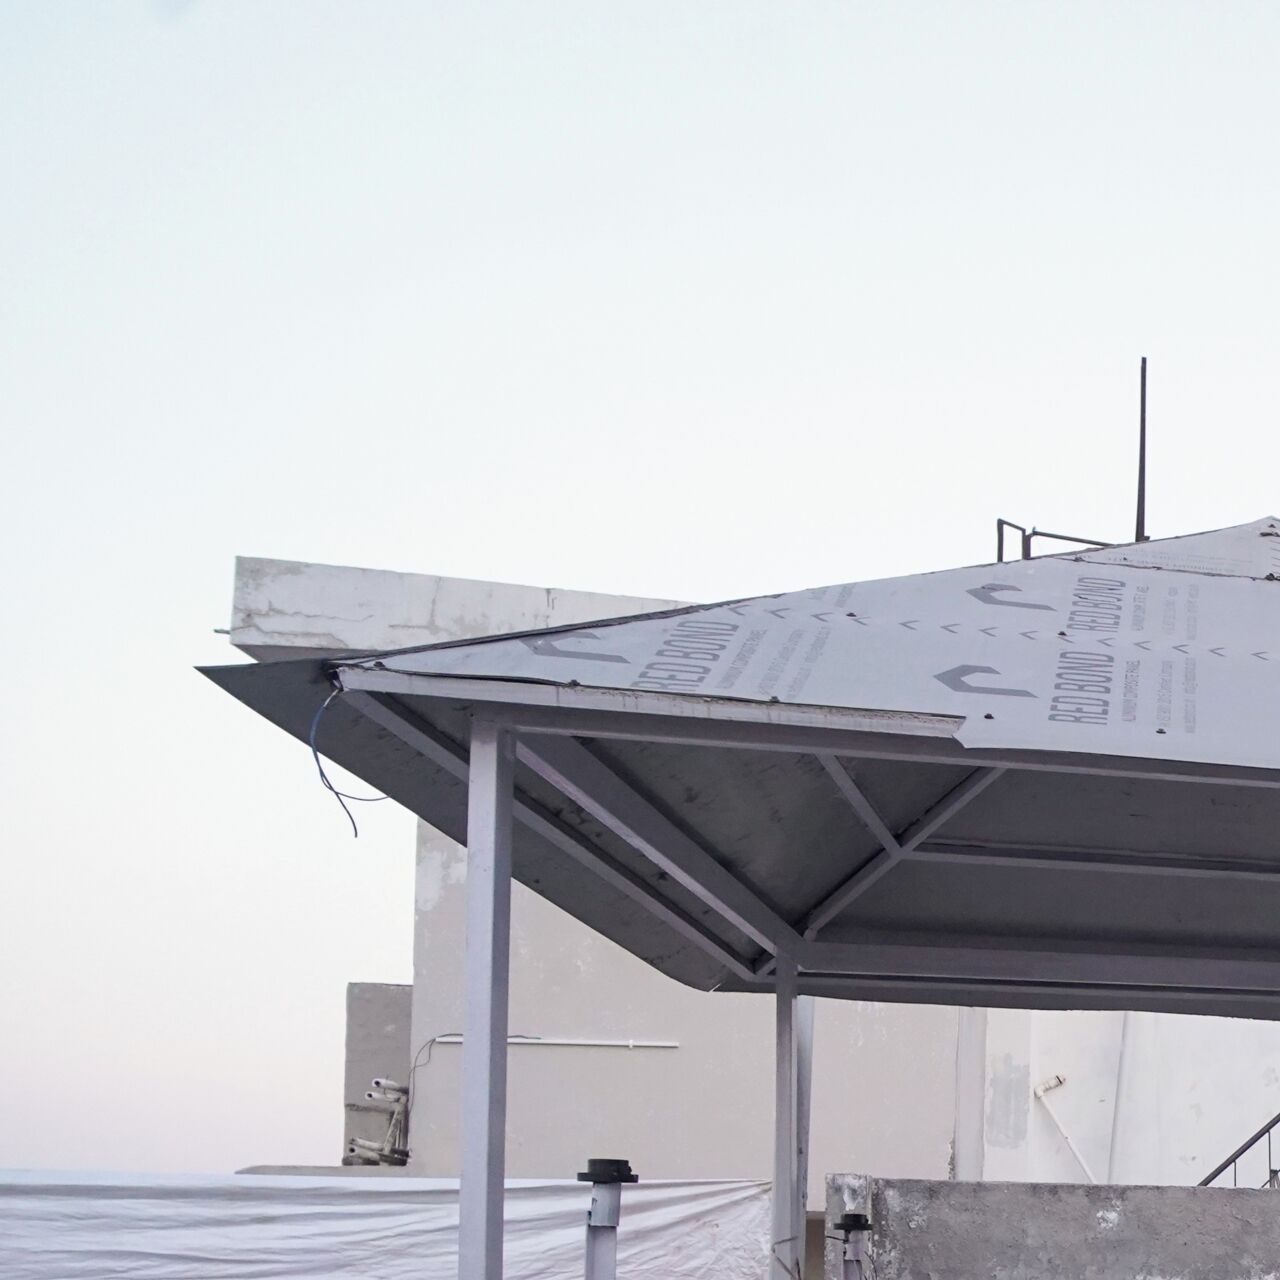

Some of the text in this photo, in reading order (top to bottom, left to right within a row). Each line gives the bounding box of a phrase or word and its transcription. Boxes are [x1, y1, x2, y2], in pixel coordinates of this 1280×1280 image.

[1067, 577, 1126, 633] RED BOND
[629, 620, 740, 692] RED BOND
[1048, 651, 1115, 726] RED BOND
